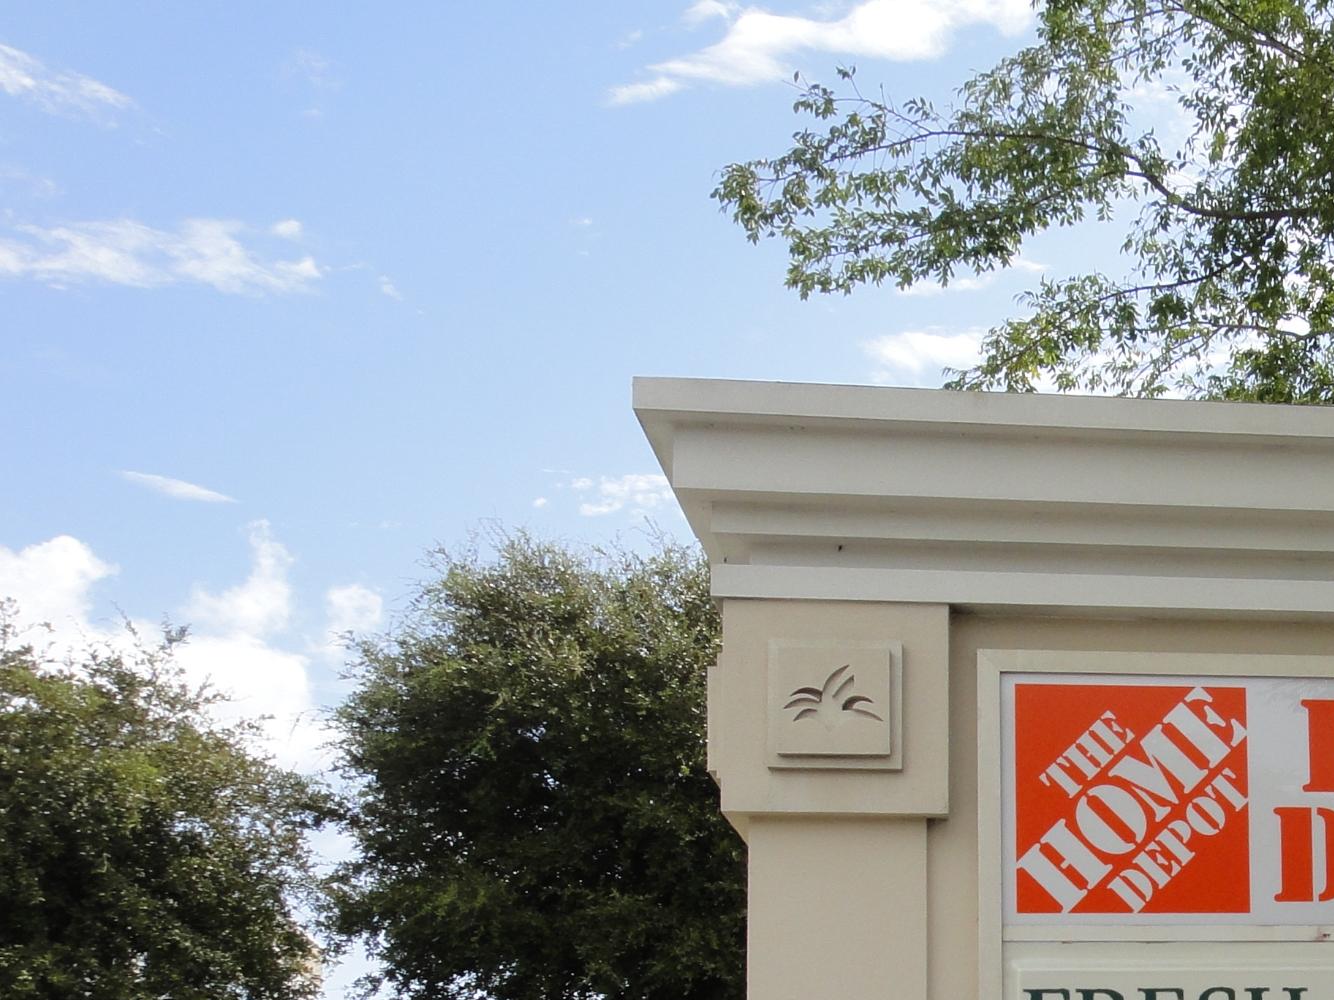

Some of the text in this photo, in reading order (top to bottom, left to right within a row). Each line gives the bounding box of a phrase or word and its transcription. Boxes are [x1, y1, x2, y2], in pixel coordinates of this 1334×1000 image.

[1016, 686, 1248, 913] HOME
[1039, 710, 1136, 800] THE
[1107, 767, 1250, 913] DEPOT
